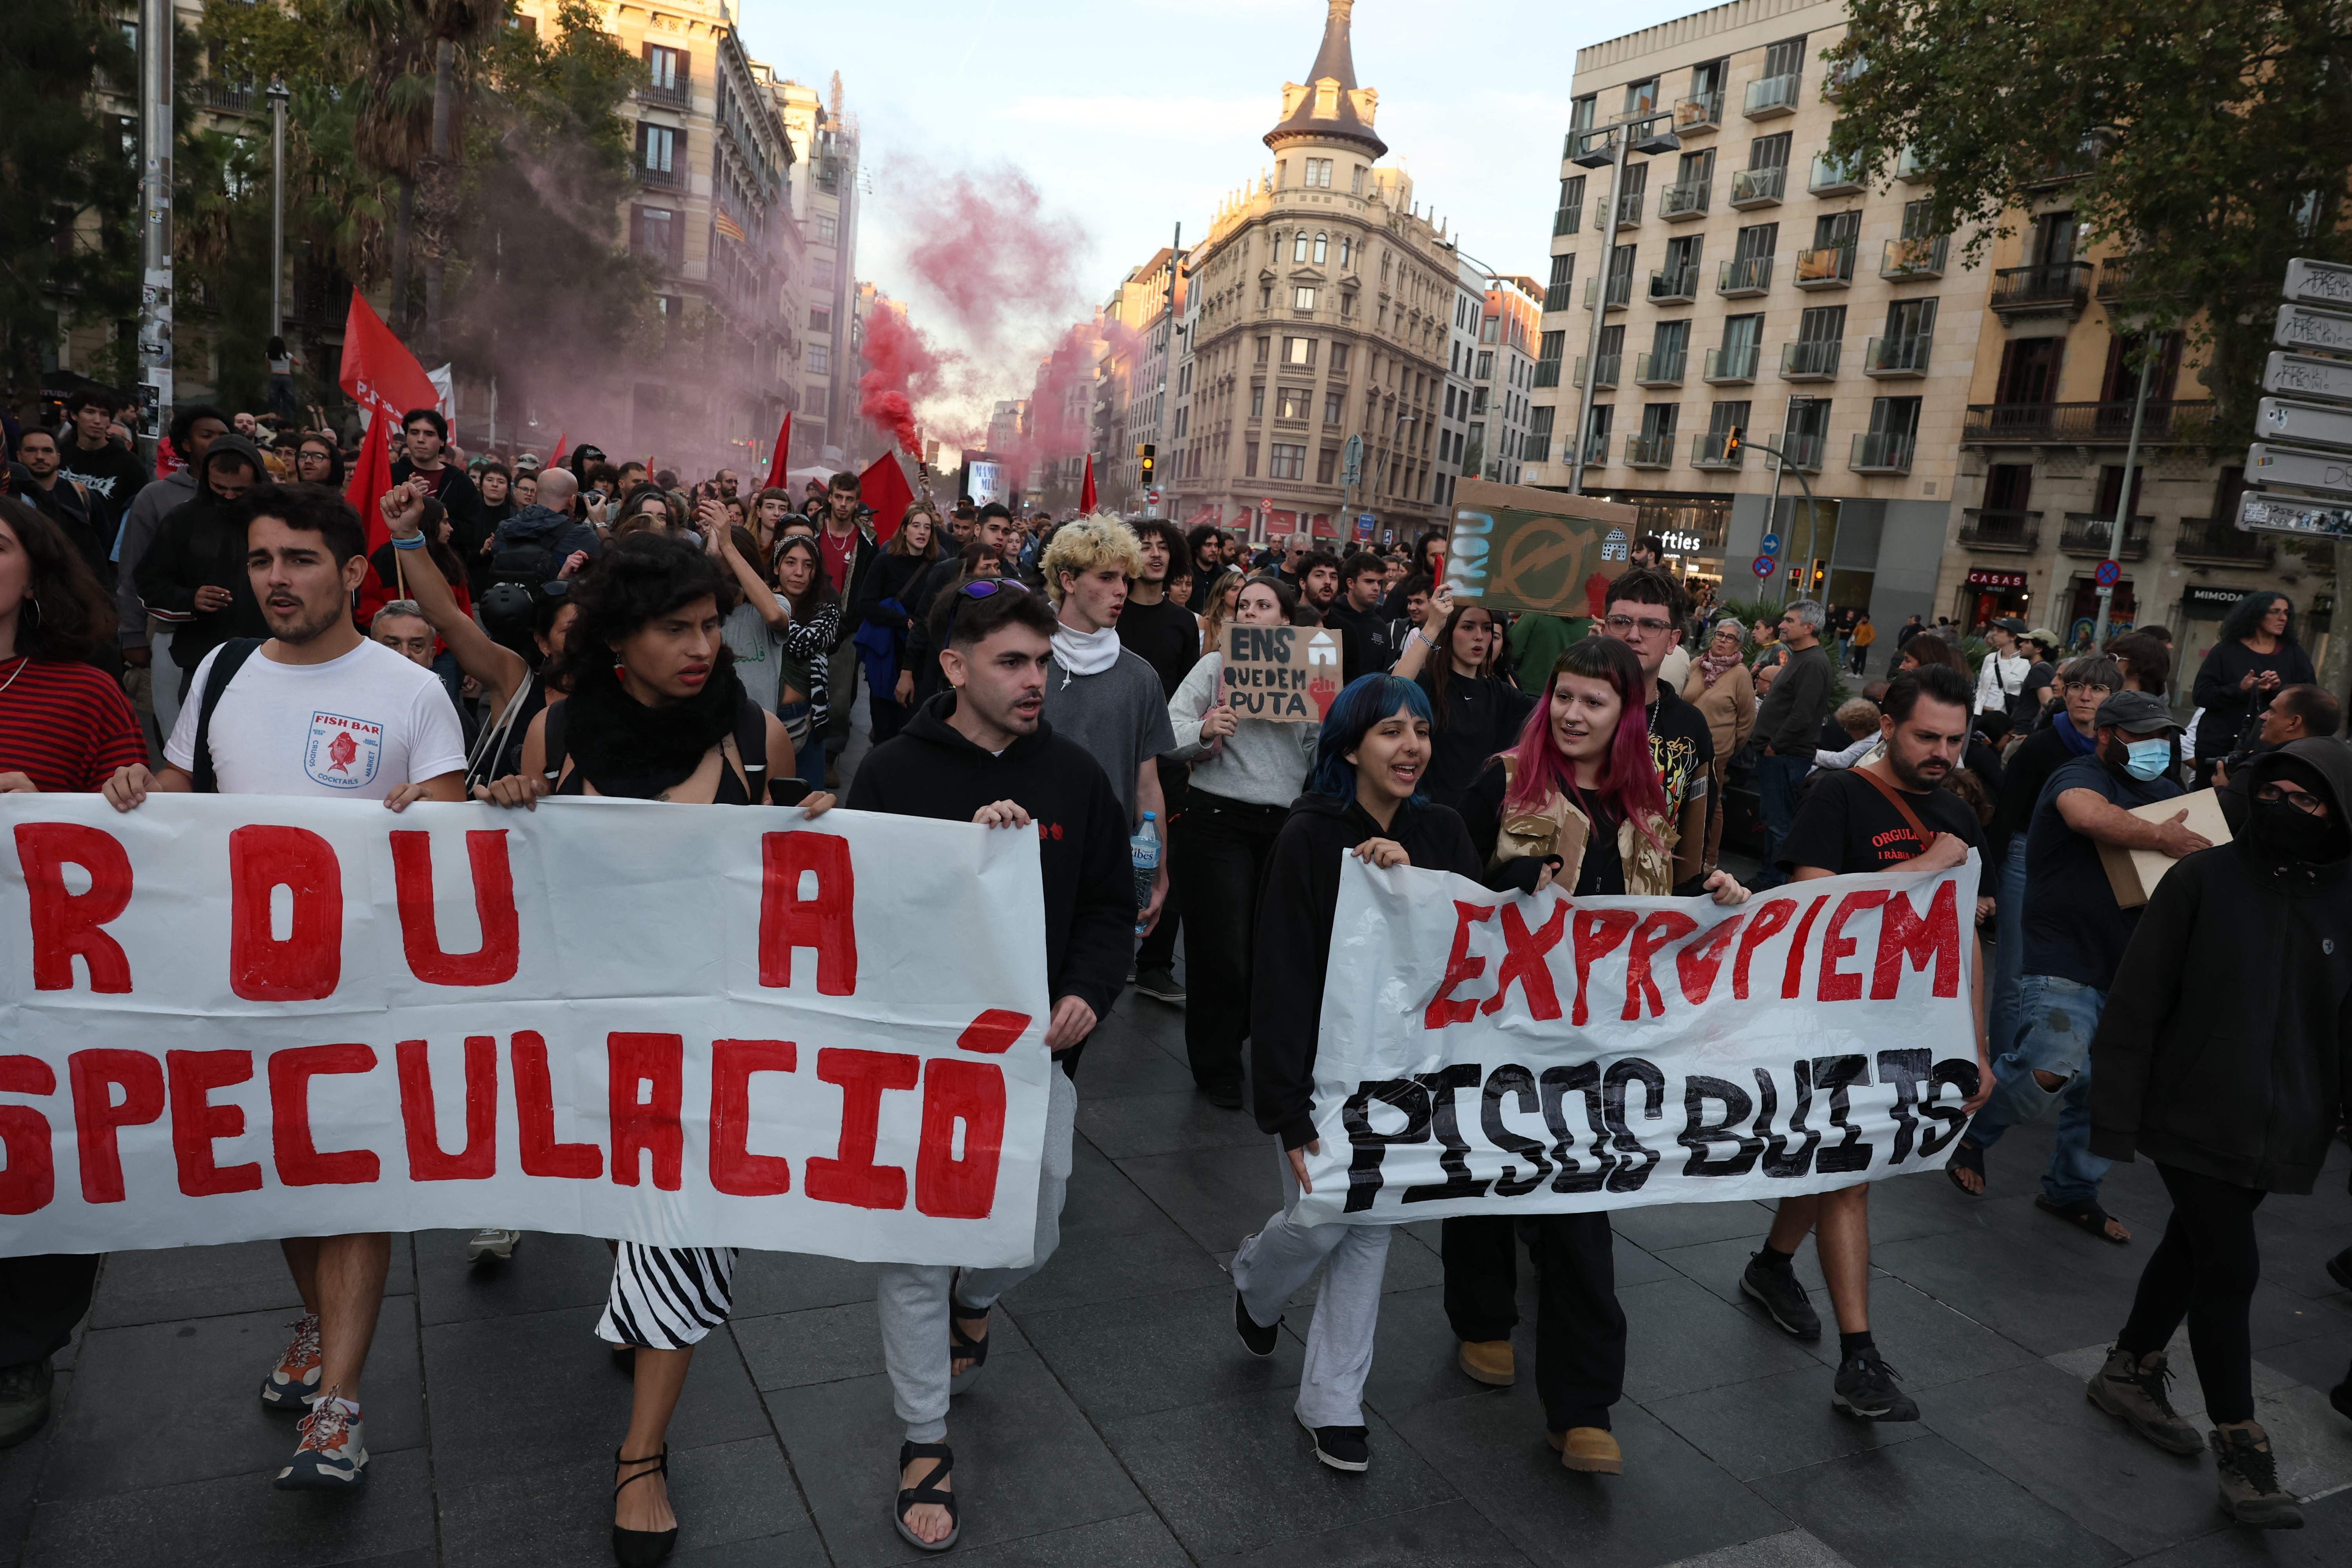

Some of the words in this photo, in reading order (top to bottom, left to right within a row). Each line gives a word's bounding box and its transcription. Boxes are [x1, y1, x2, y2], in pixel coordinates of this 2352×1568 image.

[1446, 510, 1494, 597] PROU
[1970, 573, 2022, 586] CASAS
[1231, 628, 1295, 663] ENS
[1224, 667, 1306, 690] QUEDEM
[1230, 691, 1307, 717] PUTA
[315, 715, 348, 727] FISH
[351, 722, 379, 735] BAR
[310, 740, 319, 767] CRUDOS
[365, 751, 375, 777] MARKET
[318, 773, 358, 784] COCKTAILS
[1884, 848, 1910, 860] RÀBIA
[759, 830, 858, 996] A
[1425, 880, 1960, 1029] EXPROPIEM
[1343, 1057, 1665, 1213] PISOS
[1677, 1048, 1980, 1179] BUITS
